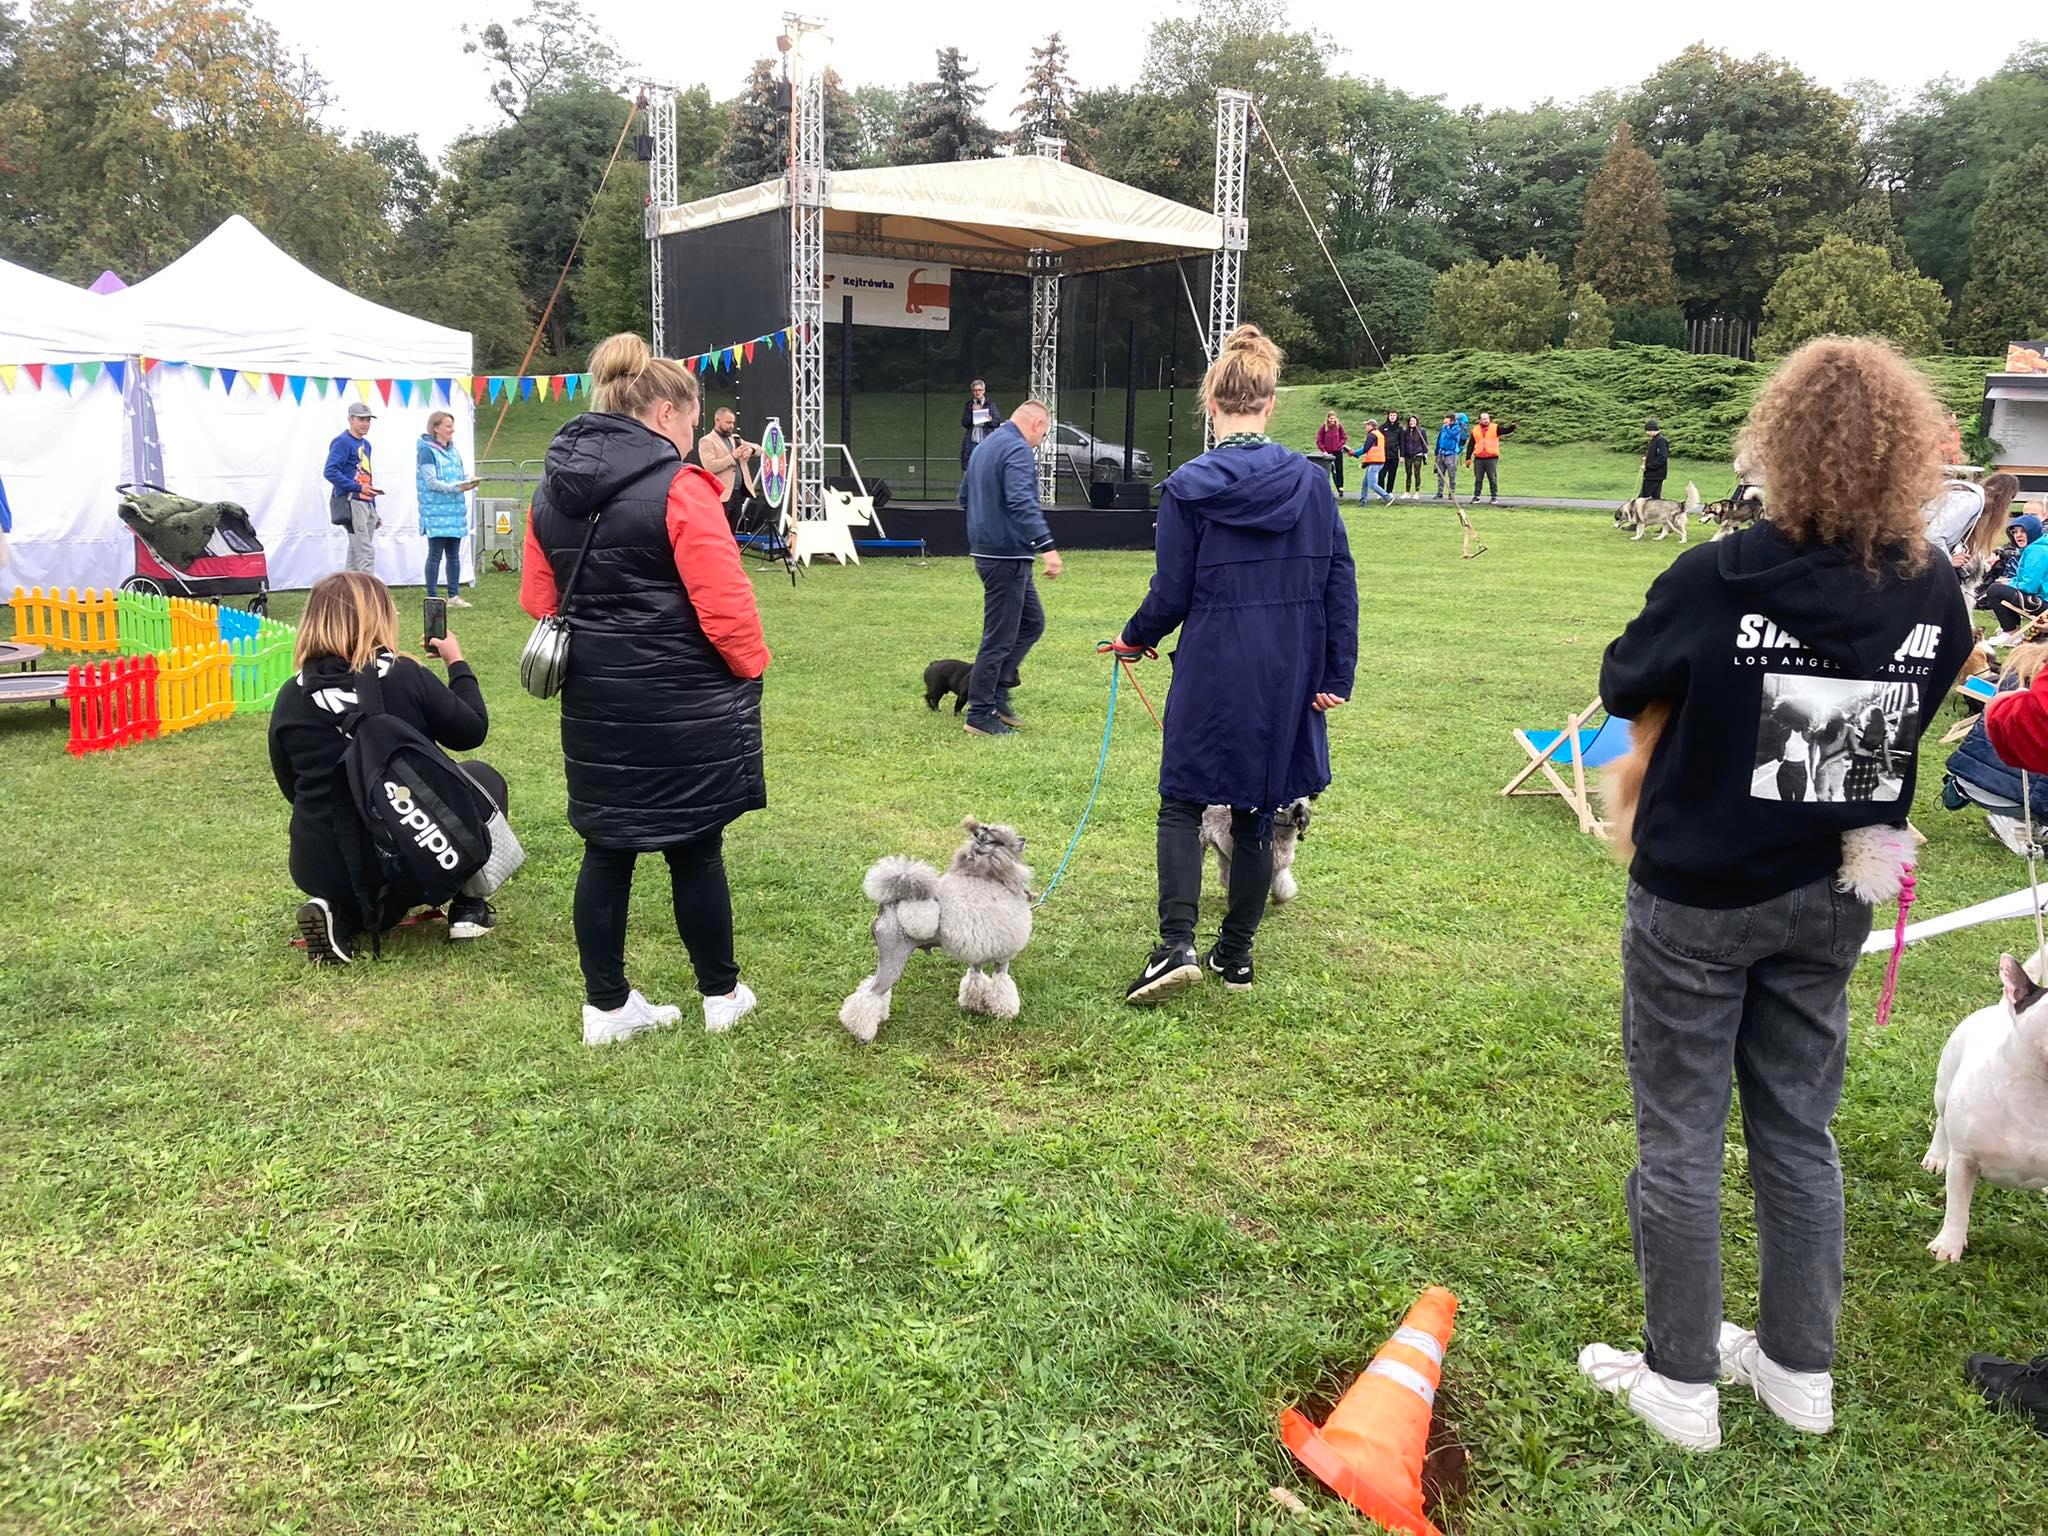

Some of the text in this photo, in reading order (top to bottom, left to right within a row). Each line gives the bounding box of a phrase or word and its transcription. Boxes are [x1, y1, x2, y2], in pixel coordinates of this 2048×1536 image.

[843, 276, 894, 289] Kejtrówka
[1734, 656, 1934, 676] LOS ANGEL ROJEC
[384, 781, 459, 870] adidas
